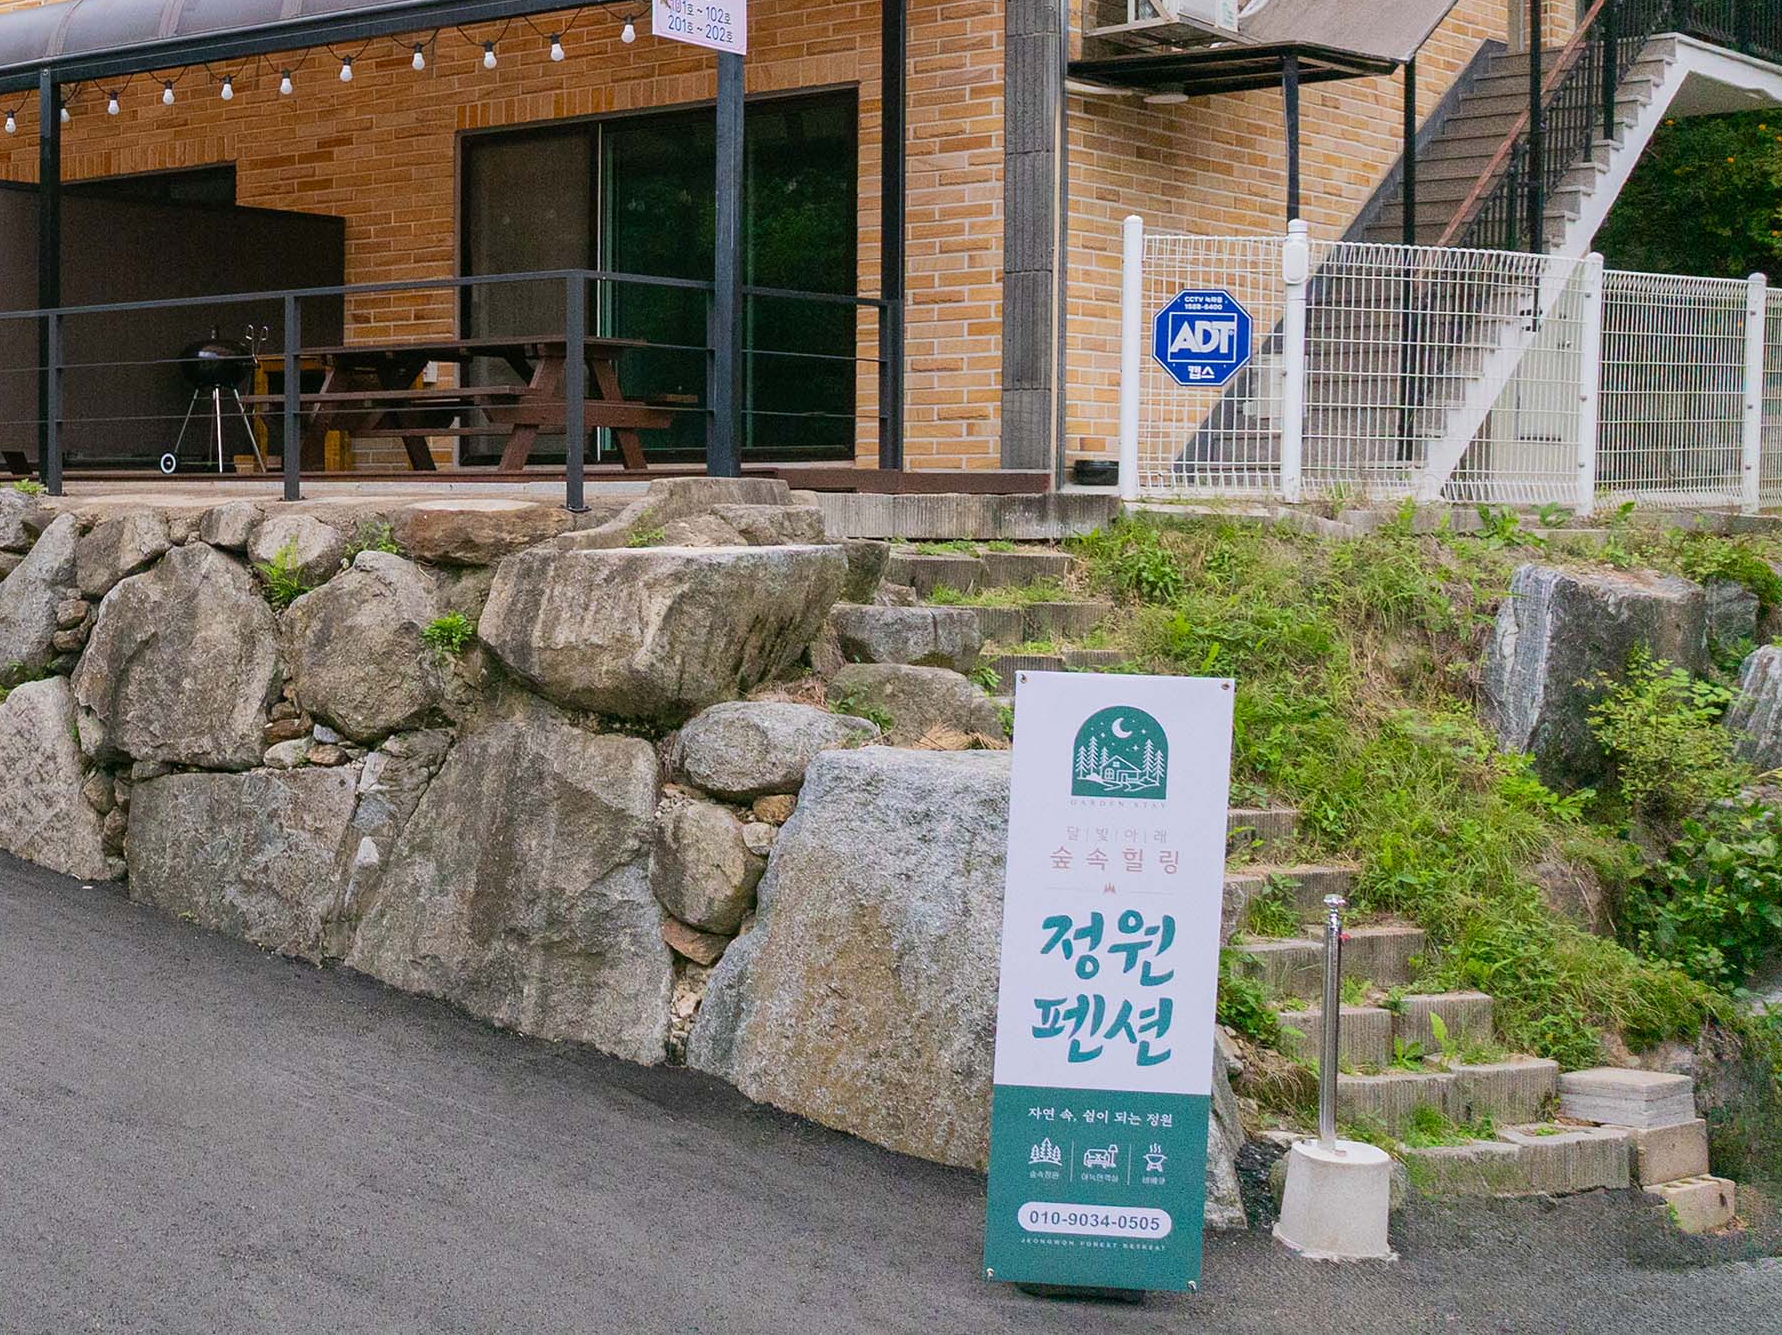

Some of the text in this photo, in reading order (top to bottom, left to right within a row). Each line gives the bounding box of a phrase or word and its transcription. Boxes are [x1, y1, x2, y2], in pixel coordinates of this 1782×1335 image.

[705, 6, 731, 25] 102호
[668, 15, 694, 34] 201호
[705, 24, 734, 43] 202호
[1170, 320, 1236, 354] ADT
[1188, 365, 1215, 380] 캡스
[1040, 909, 1176, 987] 정원
[1031, 993, 1174, 1067] 펜션
[1028, 1106, 1055, 1121] 자연
[1083, 1109, 1109, 1124] 쉼이
[1114, 1111, 1142, 1126] 되는
[1146, 1113, 1173, 1128] 정원
[1029, 1210, 1161, 1231] 010-9034-0505
